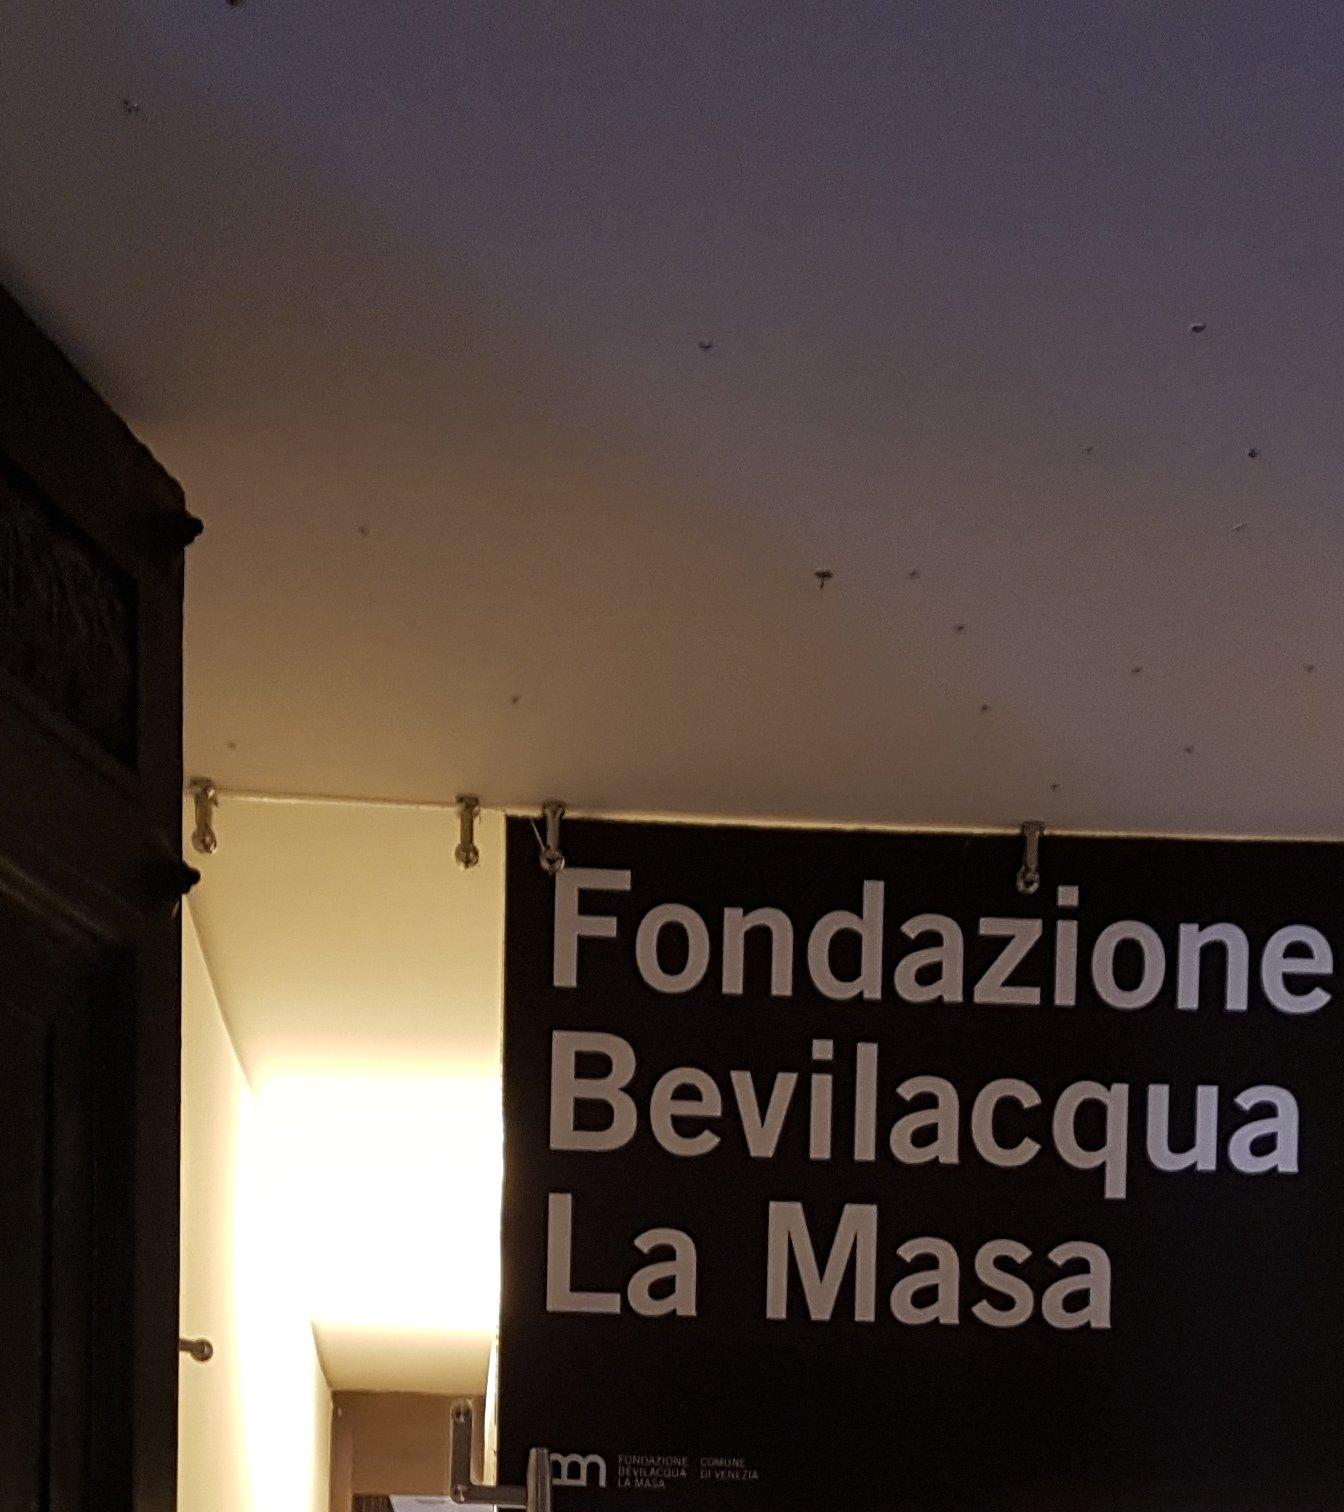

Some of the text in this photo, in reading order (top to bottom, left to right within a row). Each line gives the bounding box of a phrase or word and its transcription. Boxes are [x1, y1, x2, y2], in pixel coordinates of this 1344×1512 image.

[551, 867, 1334, 1015] Fondazione
[549, 1030, 1301, 1200] Bevilacqua
[545, 1191, 1114, 1331] La Masa
